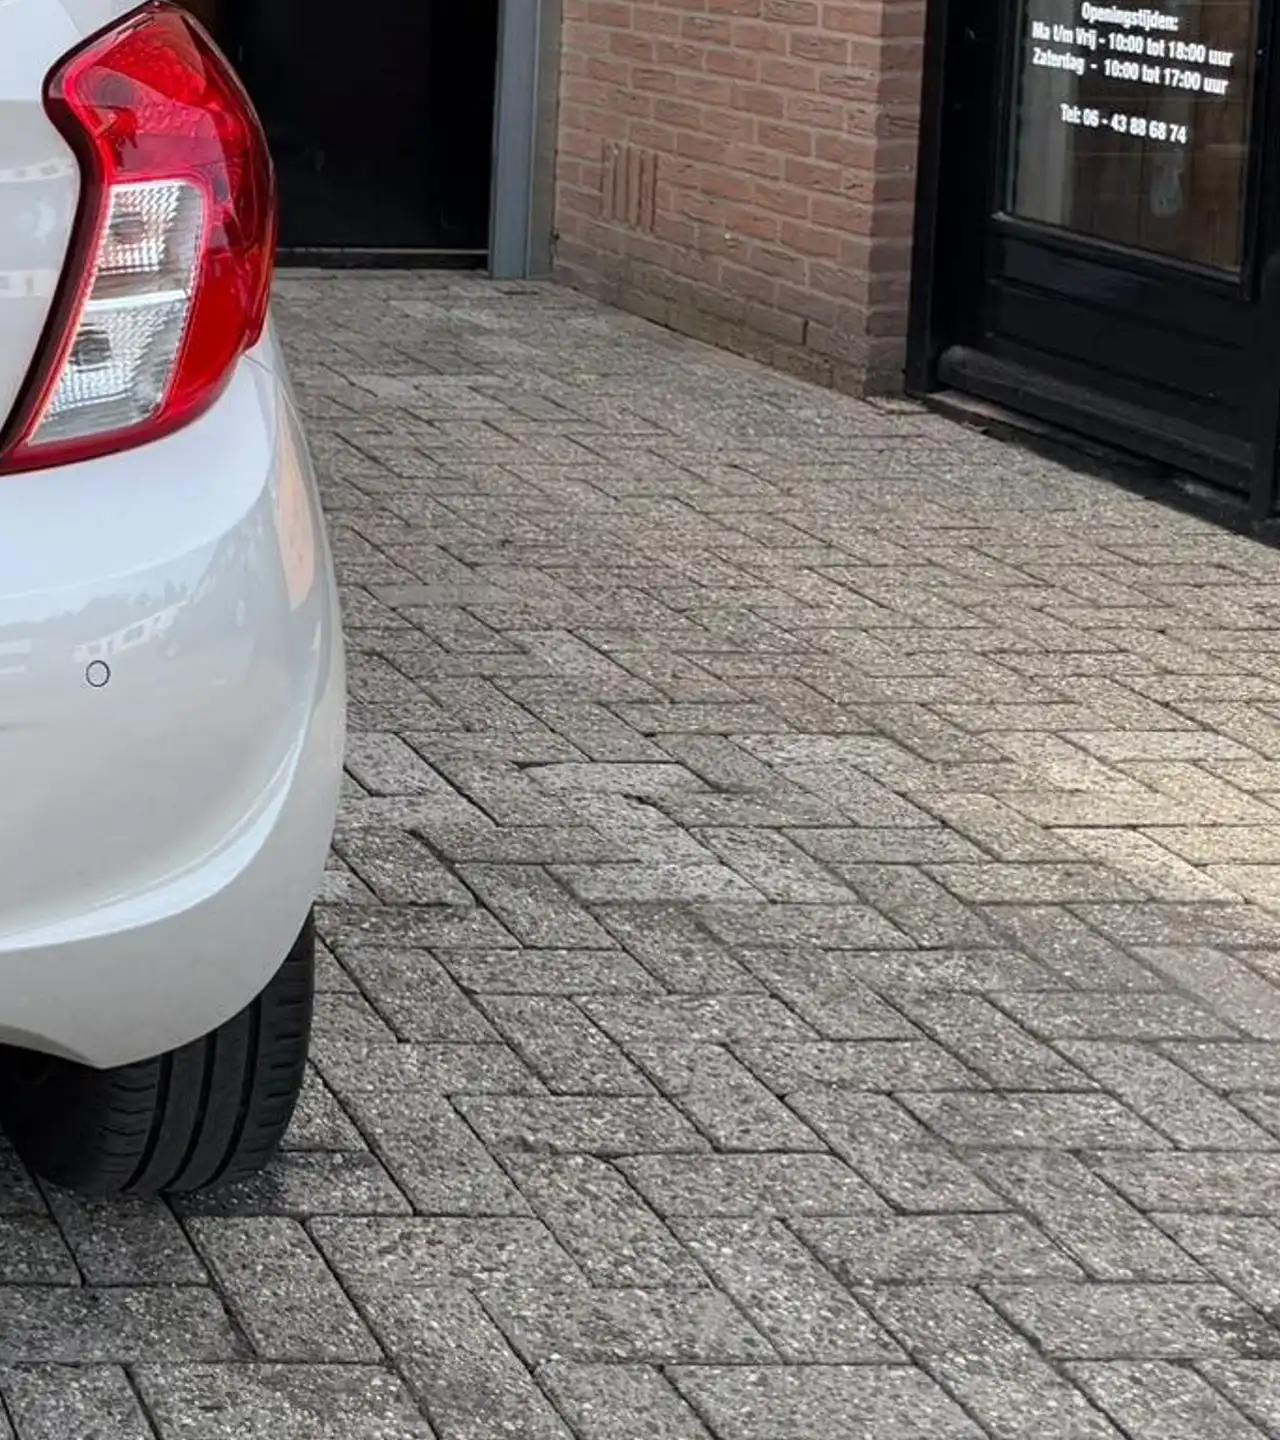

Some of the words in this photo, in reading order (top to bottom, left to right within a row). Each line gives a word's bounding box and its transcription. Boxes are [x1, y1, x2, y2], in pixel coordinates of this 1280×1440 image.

[1081, 1, 1178, 32] Openingstijden:
[1032, 20, 1050, 40] Ma
[1075, 27, 1096, 51] Vrij
[1108, 32, 1144, 54] 10:00
[1146, 37, 1165, 57] tot
[1168, 41, 1206, 63] 18:00
[1208, 48, 1234, 67] uur
[1032, 47, 1085, 76] Zaterdag
[1104, 58, 1139, 80] 10:00
[1142, 64, 1161, 84] tot
[1163, 67, 1201, 91] 17:00
[1203, 77, 1229, 95] uur
[1083, 108, 1099, 127] 06
[1110, 113, 1127, 133] 43
[1129, 117, 1146, 136] 88
[1148, 120, 1167, 140] 68
[1169, 123, 1187, 144] 74
